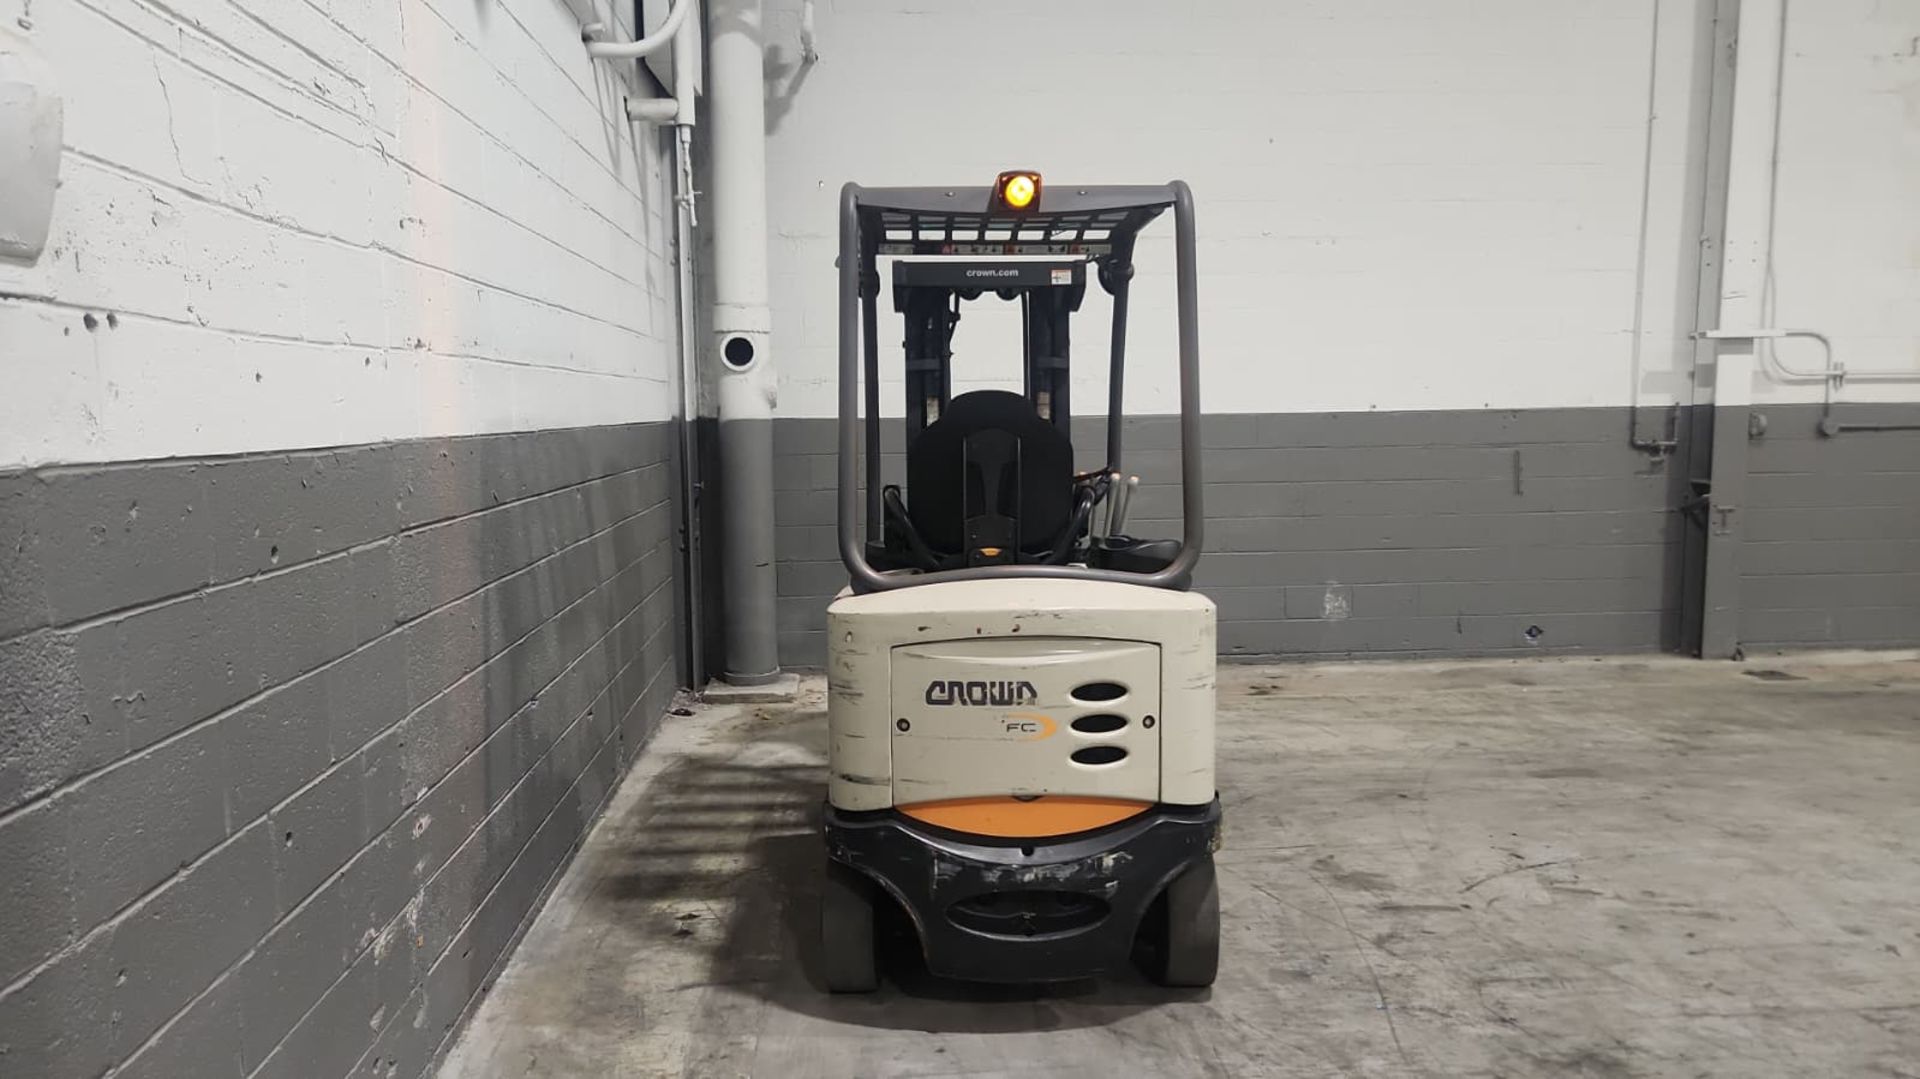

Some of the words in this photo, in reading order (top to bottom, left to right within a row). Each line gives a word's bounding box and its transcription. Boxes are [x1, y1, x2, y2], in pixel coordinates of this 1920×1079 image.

[966, 269, 1019, 277] crown.com
[925, 680, 1038, 706] CROWN
[1006, 722, 1037, 732] FC
